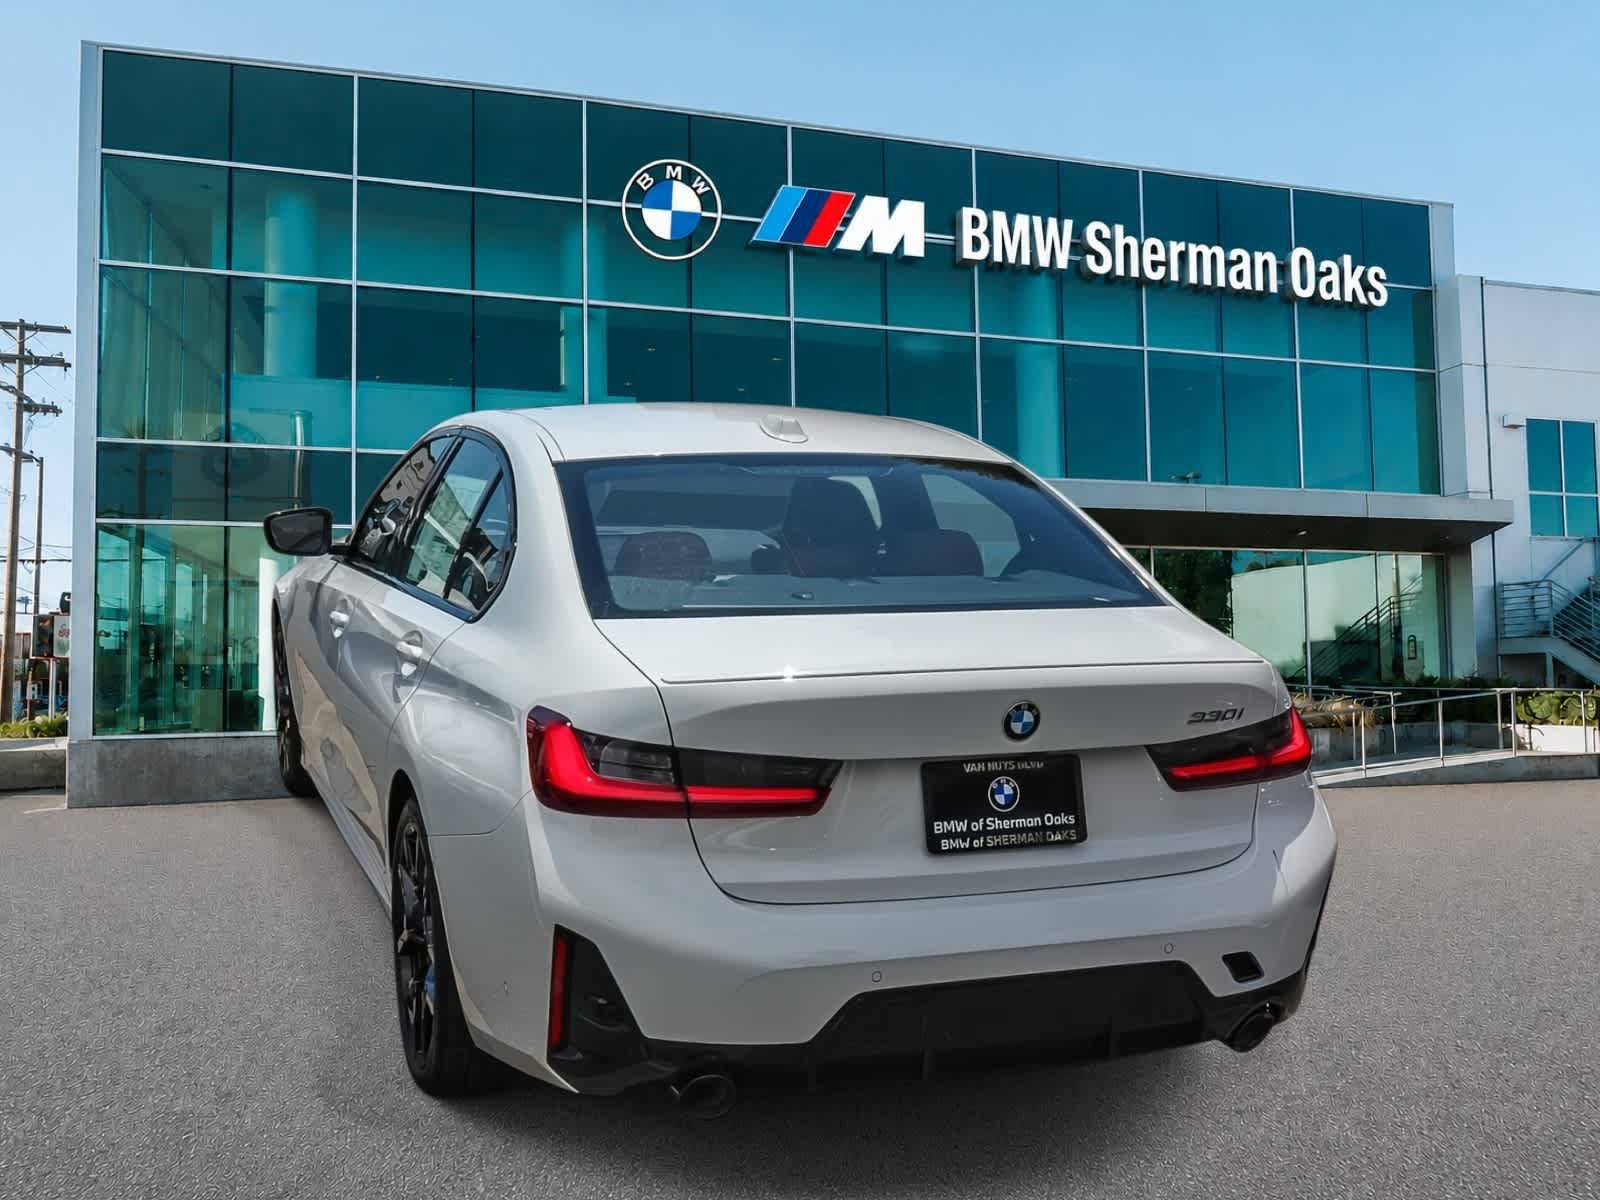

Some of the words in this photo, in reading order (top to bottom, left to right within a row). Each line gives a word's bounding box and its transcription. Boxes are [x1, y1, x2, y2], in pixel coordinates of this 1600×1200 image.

[636, 165, 711, 196] BMW
[834, 195, 925, 258] M
[961, 206, 1073, 270] BMW
[1084, 221, 1278, 294] Sherman
[1289, 246, 1389, 308] Oaks
[963, 762, 985, 773] VAN
[933, 819, 968, 834] BMW
[971, 818, 984, 831] of
[986, 815, 1041, 830] Sherman
[1044, 812, 1075, 826] Oaks
[941, 837, 970, 850] BMW
[973, 836, 984, 848] of
[986, 831, 1044, 847] SHERMAN
[1046, 830, 1077, 842] OAKS
